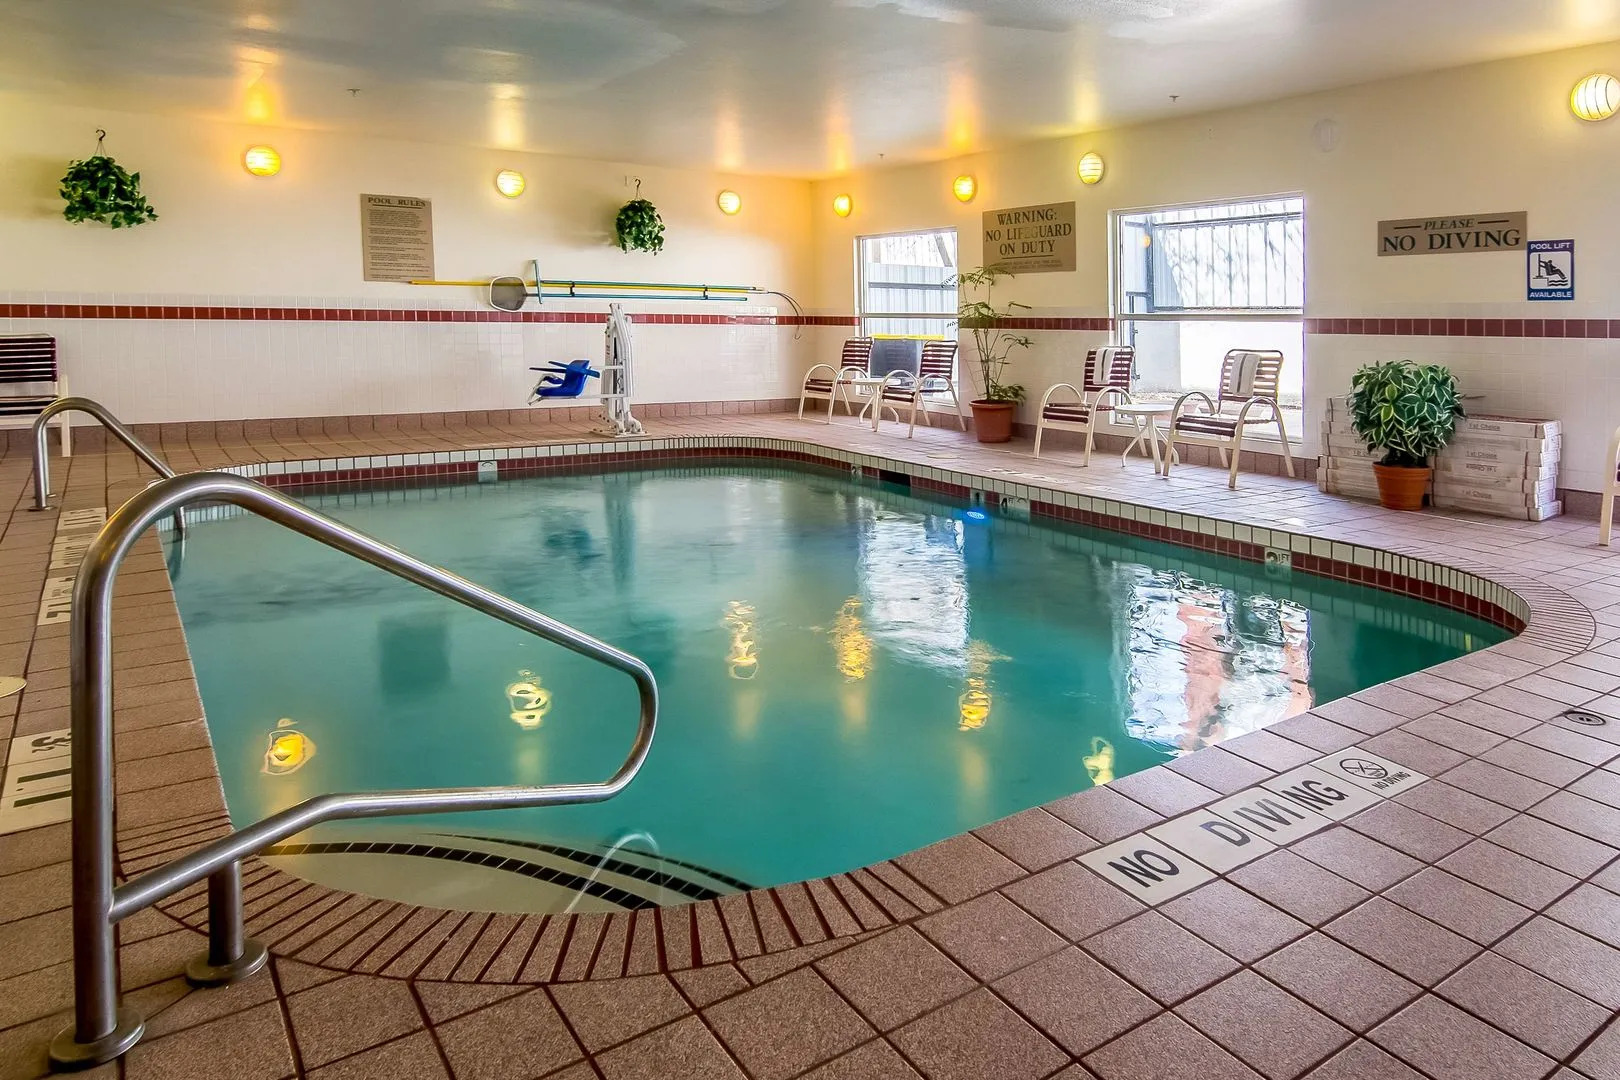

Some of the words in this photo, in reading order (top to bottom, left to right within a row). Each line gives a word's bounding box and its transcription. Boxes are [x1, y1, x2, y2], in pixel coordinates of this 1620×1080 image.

[997, 208, 1057, 226] WARNING:
[1424, 219, 1475, 230] PLEASE
[985, 229, 1001, 242] NO
[1007, 223, 1072, 240] LIFEGUARD
[1383, 235, 1416, 252] NO
[1428, 229, 1520, 250] DIVING
[1000, 243, 1015, 255] ON
[1022, 240, 1055, 254] DUTY
[1107, 849, 1180, 888] NO
[1199, 779, 1349, 847] DIVING
